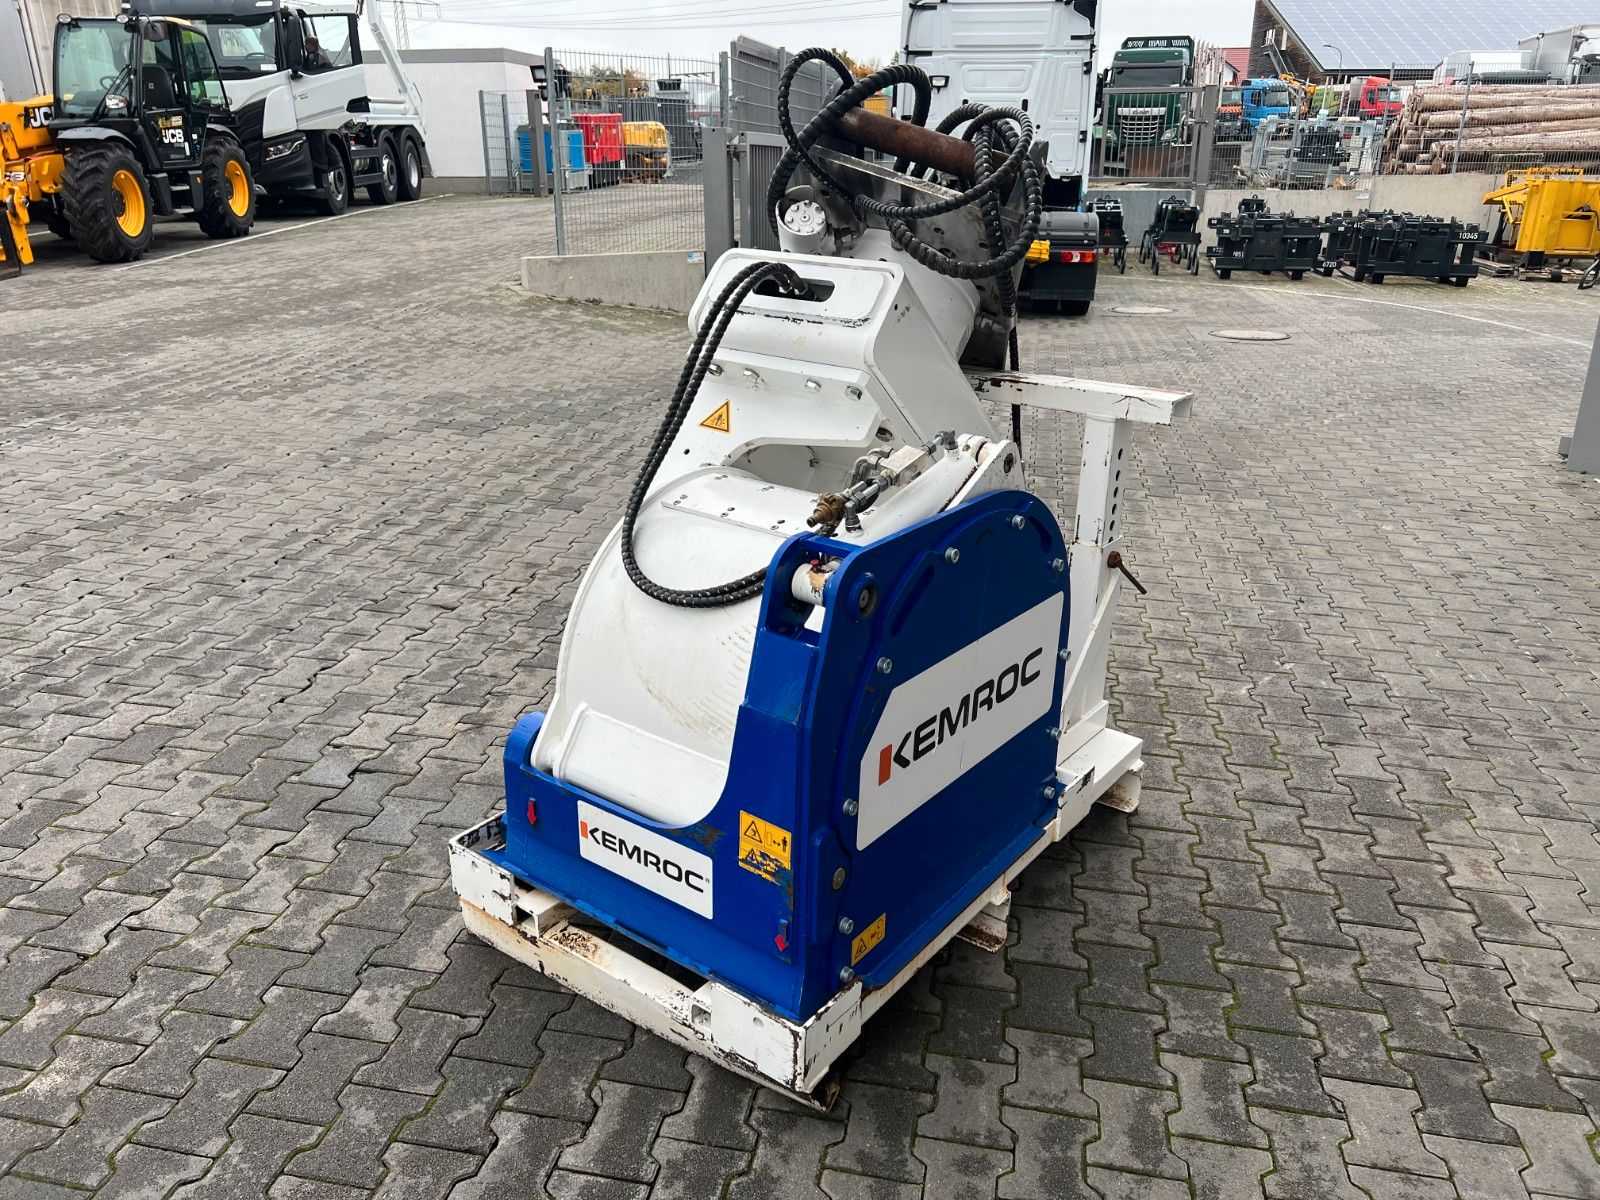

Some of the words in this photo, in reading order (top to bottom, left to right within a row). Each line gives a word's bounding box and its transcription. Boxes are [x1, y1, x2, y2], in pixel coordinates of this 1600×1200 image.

[29, 107, 55, 128] JC
[162, 129, 184, 144] JCB
[878, 647, 1043, 786] KEMROC
[580, 820, 704, 894] KEMROC
